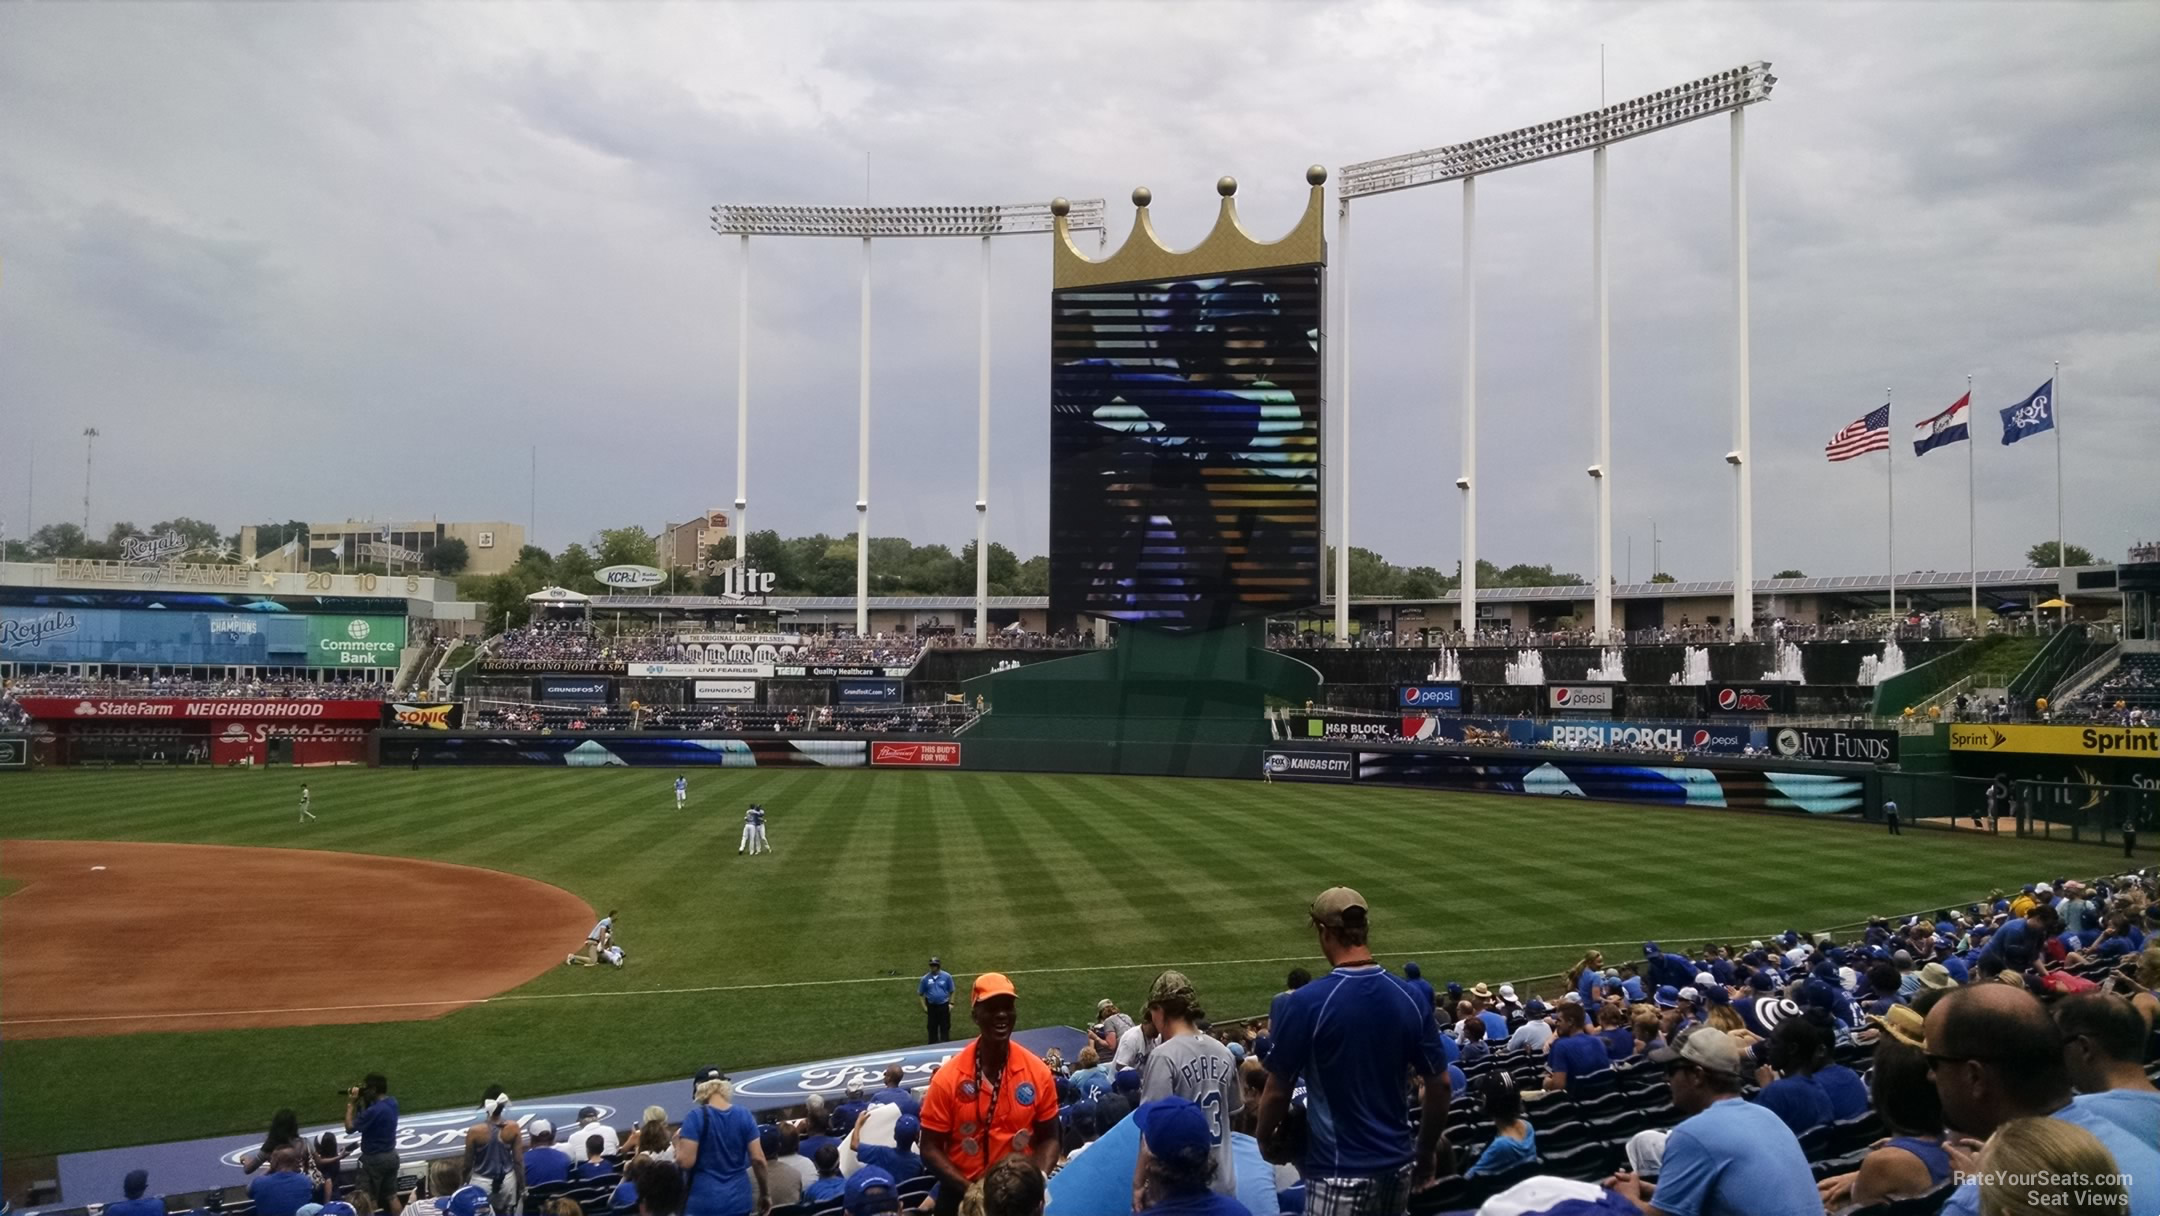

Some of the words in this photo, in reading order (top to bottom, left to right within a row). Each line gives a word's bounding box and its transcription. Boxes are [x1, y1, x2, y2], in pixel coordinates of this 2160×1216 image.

[120, 530, 189, 564] Royals
[55, 558, 135, 582] HALL
[141, 566, 162, 586] of
[168, 562, 249, 586] FAME
[607, 572, 637, 583] KCP&L
[306, 571, 332, 590] 20
[356, 573, 377, 592] 10
[406, 576, 419, 593] 5
[0, 611, 78, 647] Royals
[211, 621, 256, 633] CHAMPIONS
[320, 639, 395, 651] Commerce
[340, 652, 376, 664] Bank
[482, 662, 521, 670] ARGOSY
[776, 667, 806, 676] TEVA
[813, 668, 837, 676] Quality
[1422, 690, 1452, 702] pepsi
[1574, 692, 1606, 706] pepsi
[185, 703, 324, 716] NEIGHBORHOOD
[400, 712, 448, 722] SONIC
[1326, 723, 1348, 734] H&R
[1350, 724, 1386, 734] BLOCK
[1553, 725, 1606, 746] PEPSI
[1610, 726, 1682, 750] PORCH
[1712, 736, 1738, 746] pepsi
[1952, 732, 1988, 748] Sprint
[2082, 728, 2158, 753] Sprint
[936, 746, 956, 754] BUD'S
[1802, 732, 1831, 756] IVY
[1834, 732, 1890, 760] FUNDS
[1291, 758, 1328, 770] KANSAS
[1328, 760, 1349, 770] CITY
[1181, 1054, 1230, 1088] PEREZ
